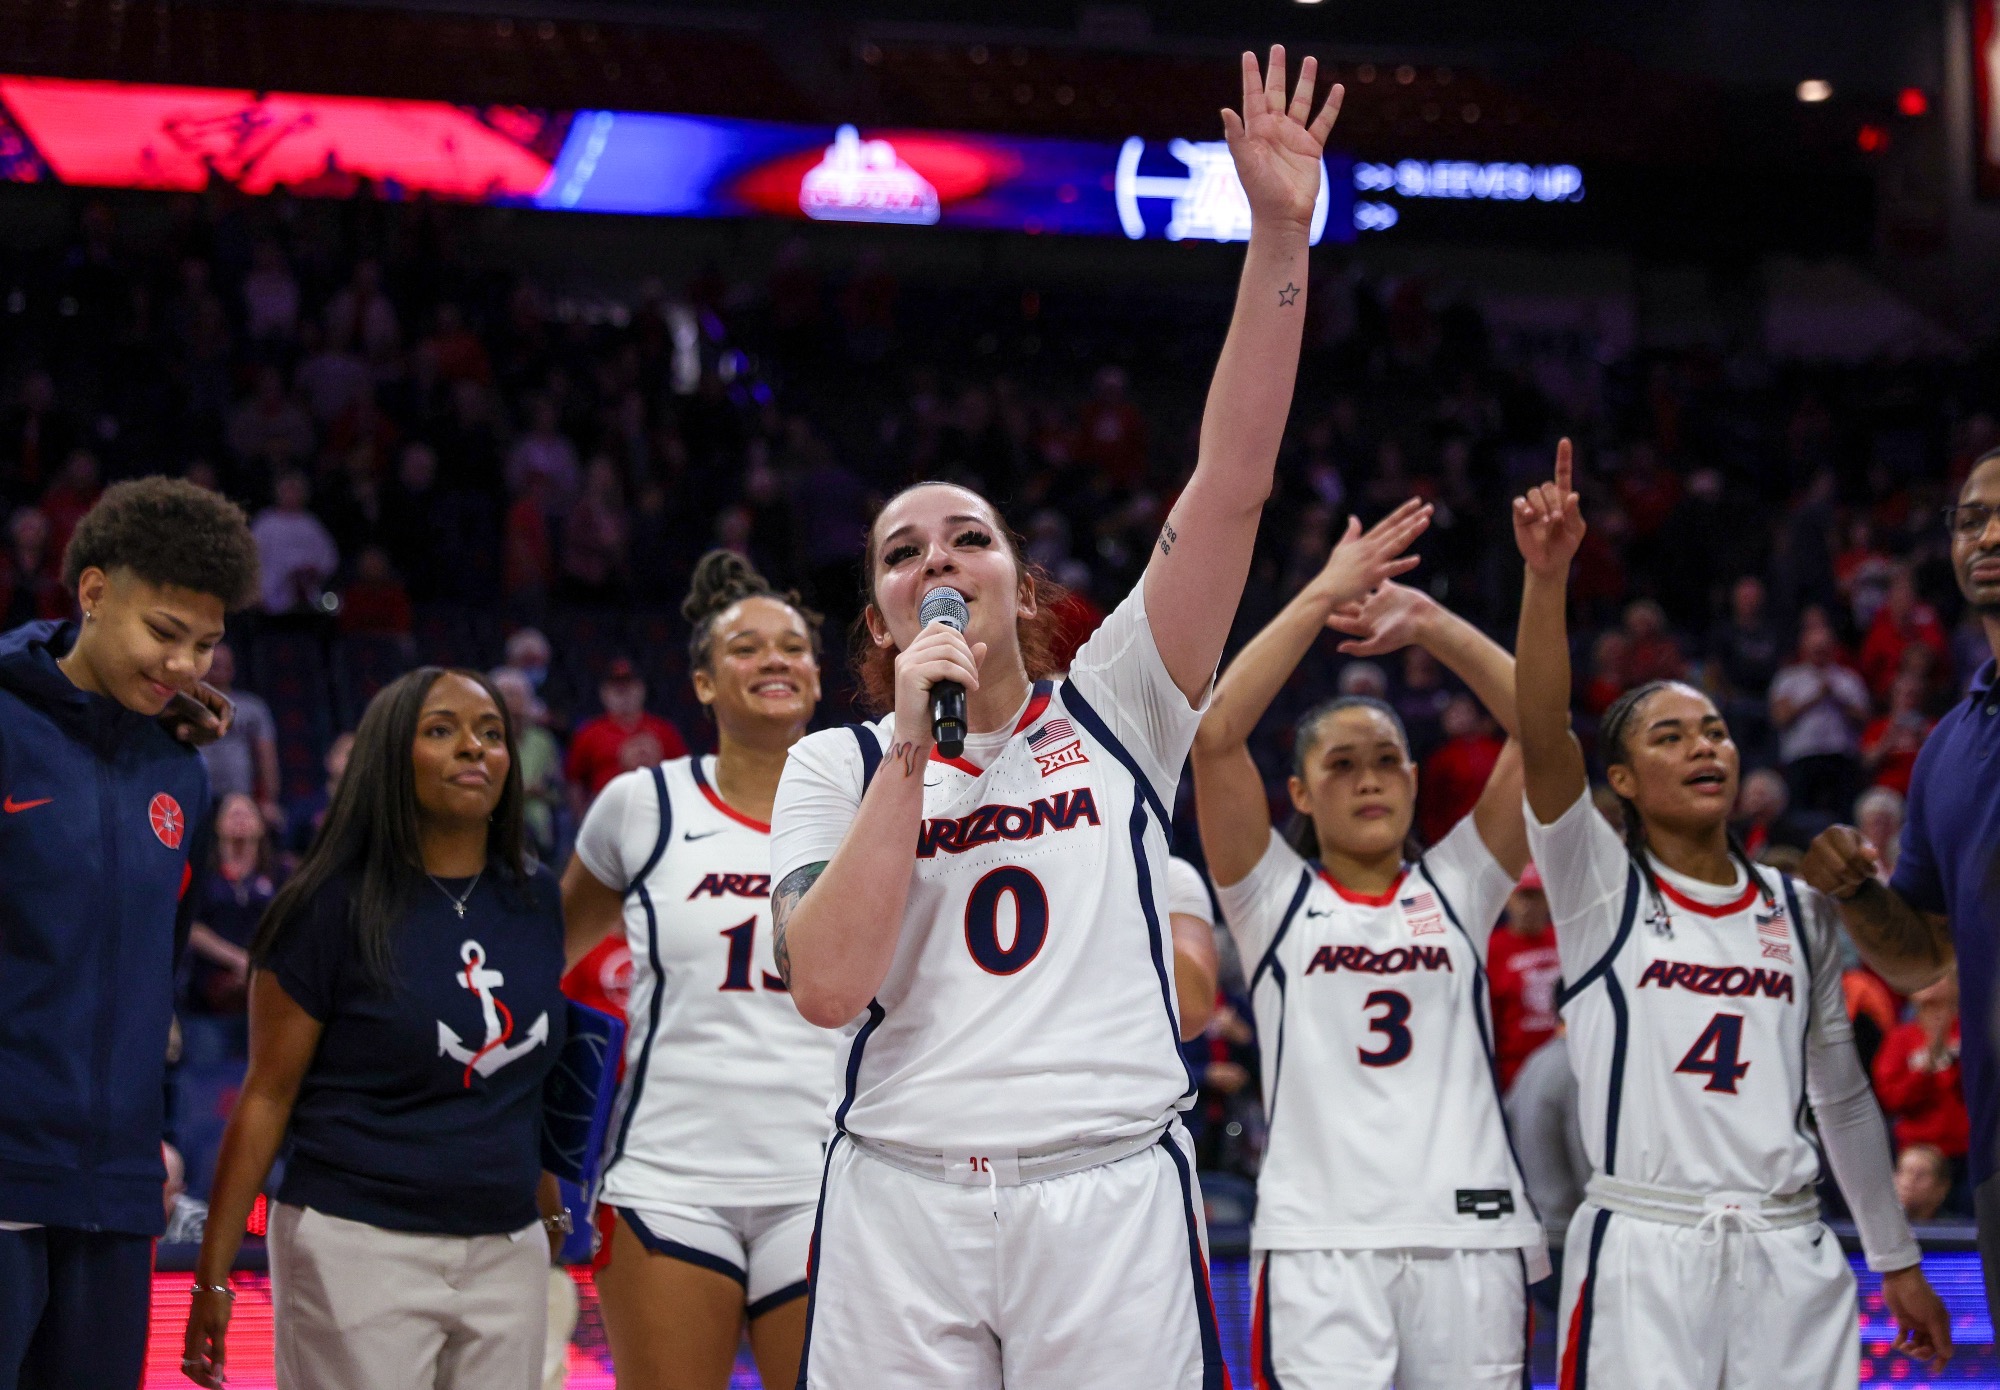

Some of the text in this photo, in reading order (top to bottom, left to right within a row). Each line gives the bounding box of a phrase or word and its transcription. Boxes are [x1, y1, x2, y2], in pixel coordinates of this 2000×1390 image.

[684, 872, 771, 901] ARIZ
[964, 865, 1050, 976] 0
[718, 914, 791, 993] 1
[1304, 944, 1453, 975] ARIZONA
[1636, 958, 1794, 1005] ARIZONA
[1356, 989, 1413, 1067] 3
[1672, 1012, 1752, 1095] 4
